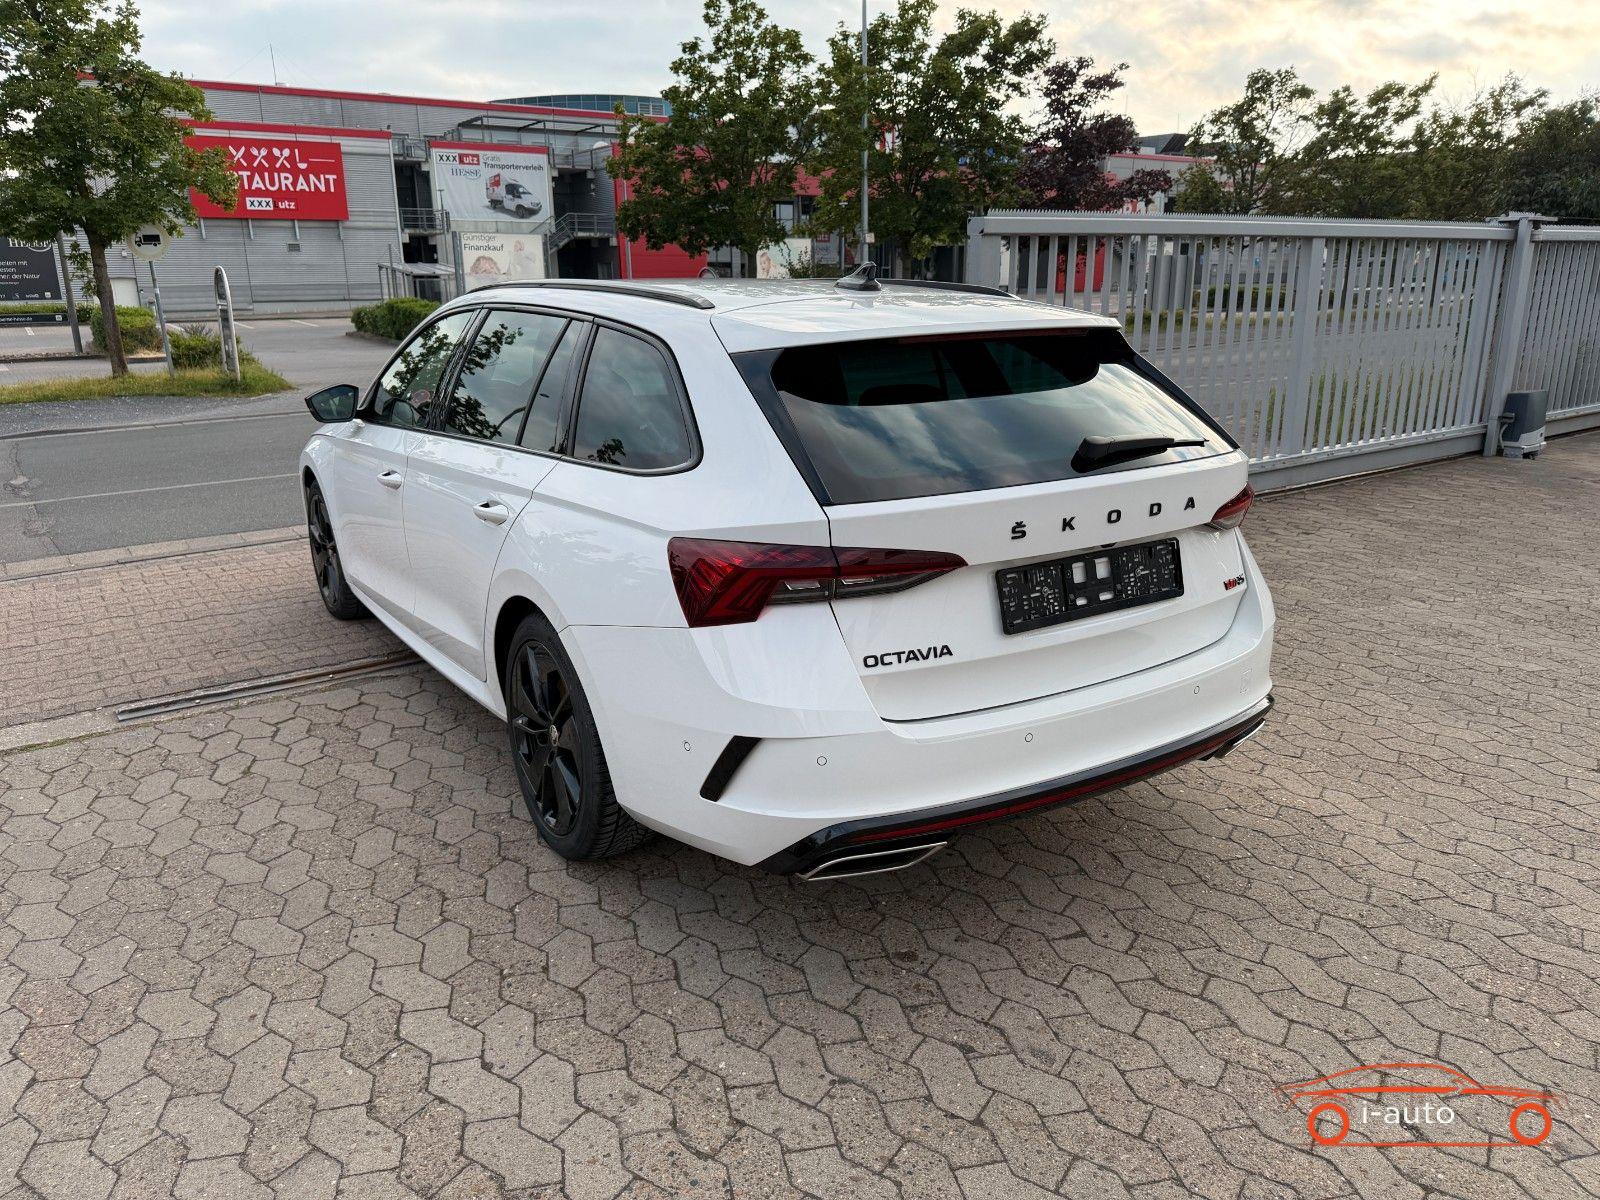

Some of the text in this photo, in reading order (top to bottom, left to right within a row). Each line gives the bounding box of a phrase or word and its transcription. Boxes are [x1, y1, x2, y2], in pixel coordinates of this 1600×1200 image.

[482, 154, 500, 162] Gratis
[484, 162, 544, 172] Transporterverleih
[451, 168, 482, 178] HESSE
[235, 170, 337, 193] TAURANT
[463, 243, 504, 252] Finanzkauf
[1011, 496, 1196, 540] ŠKODA
[863, 644, 953, 668] OCTAVIA
